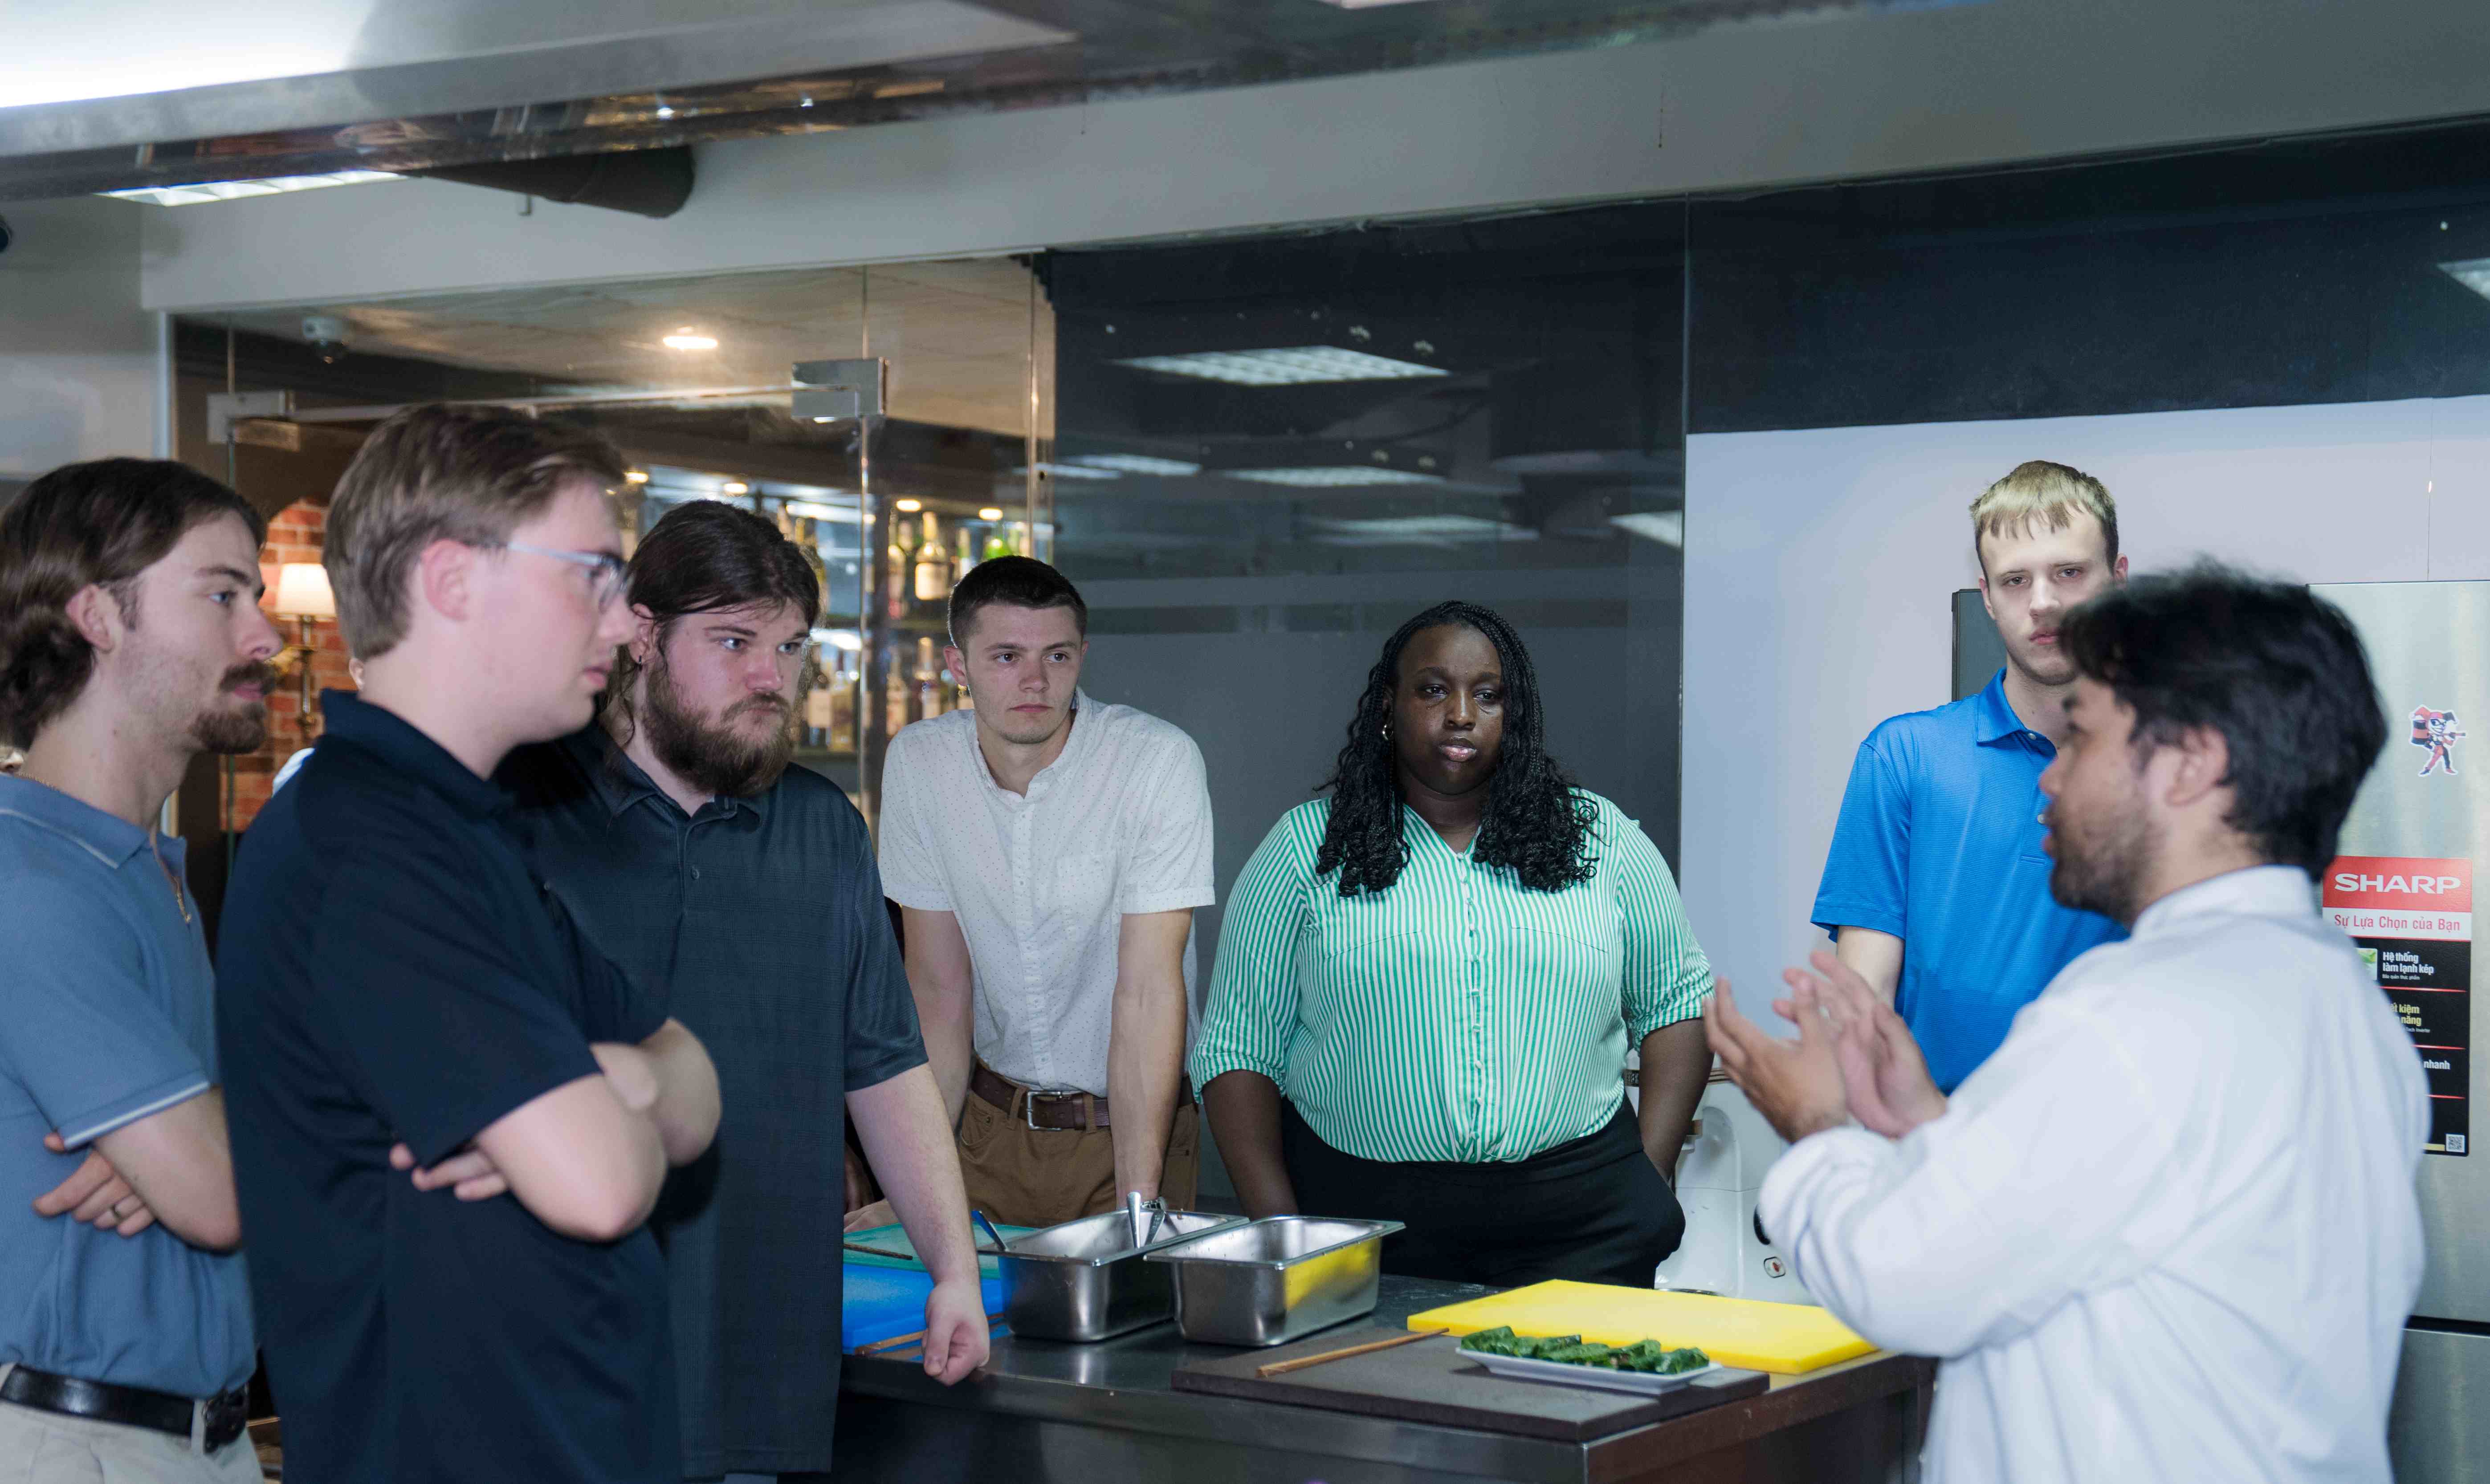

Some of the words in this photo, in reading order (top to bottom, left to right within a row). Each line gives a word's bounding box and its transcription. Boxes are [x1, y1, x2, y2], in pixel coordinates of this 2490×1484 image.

[2334, 873, 2461, 894] SHARP
[2335, 914, 2349, 929] Sự
[2354, 915, 2374, 930] Lựa
[2379, 916, 2407, 931] Chọn
[2413, 916, 2433, 930] của
[2438, 919, 2460, 932] Bạn
[2383, 951, 2395, 963] Hệ
[2395, 951, 2419, 964] thống
[2383, 962, 2399, 972] làm
[2400, 963, 2418, 974] lạnh
[2419, 964, 2434, 976] kép
[2399, 1004, 2420, 1015] kiệm
[2401, 1016, 2421, 1026] năng
[2424, 1059, 2450, 1069] nhanh
